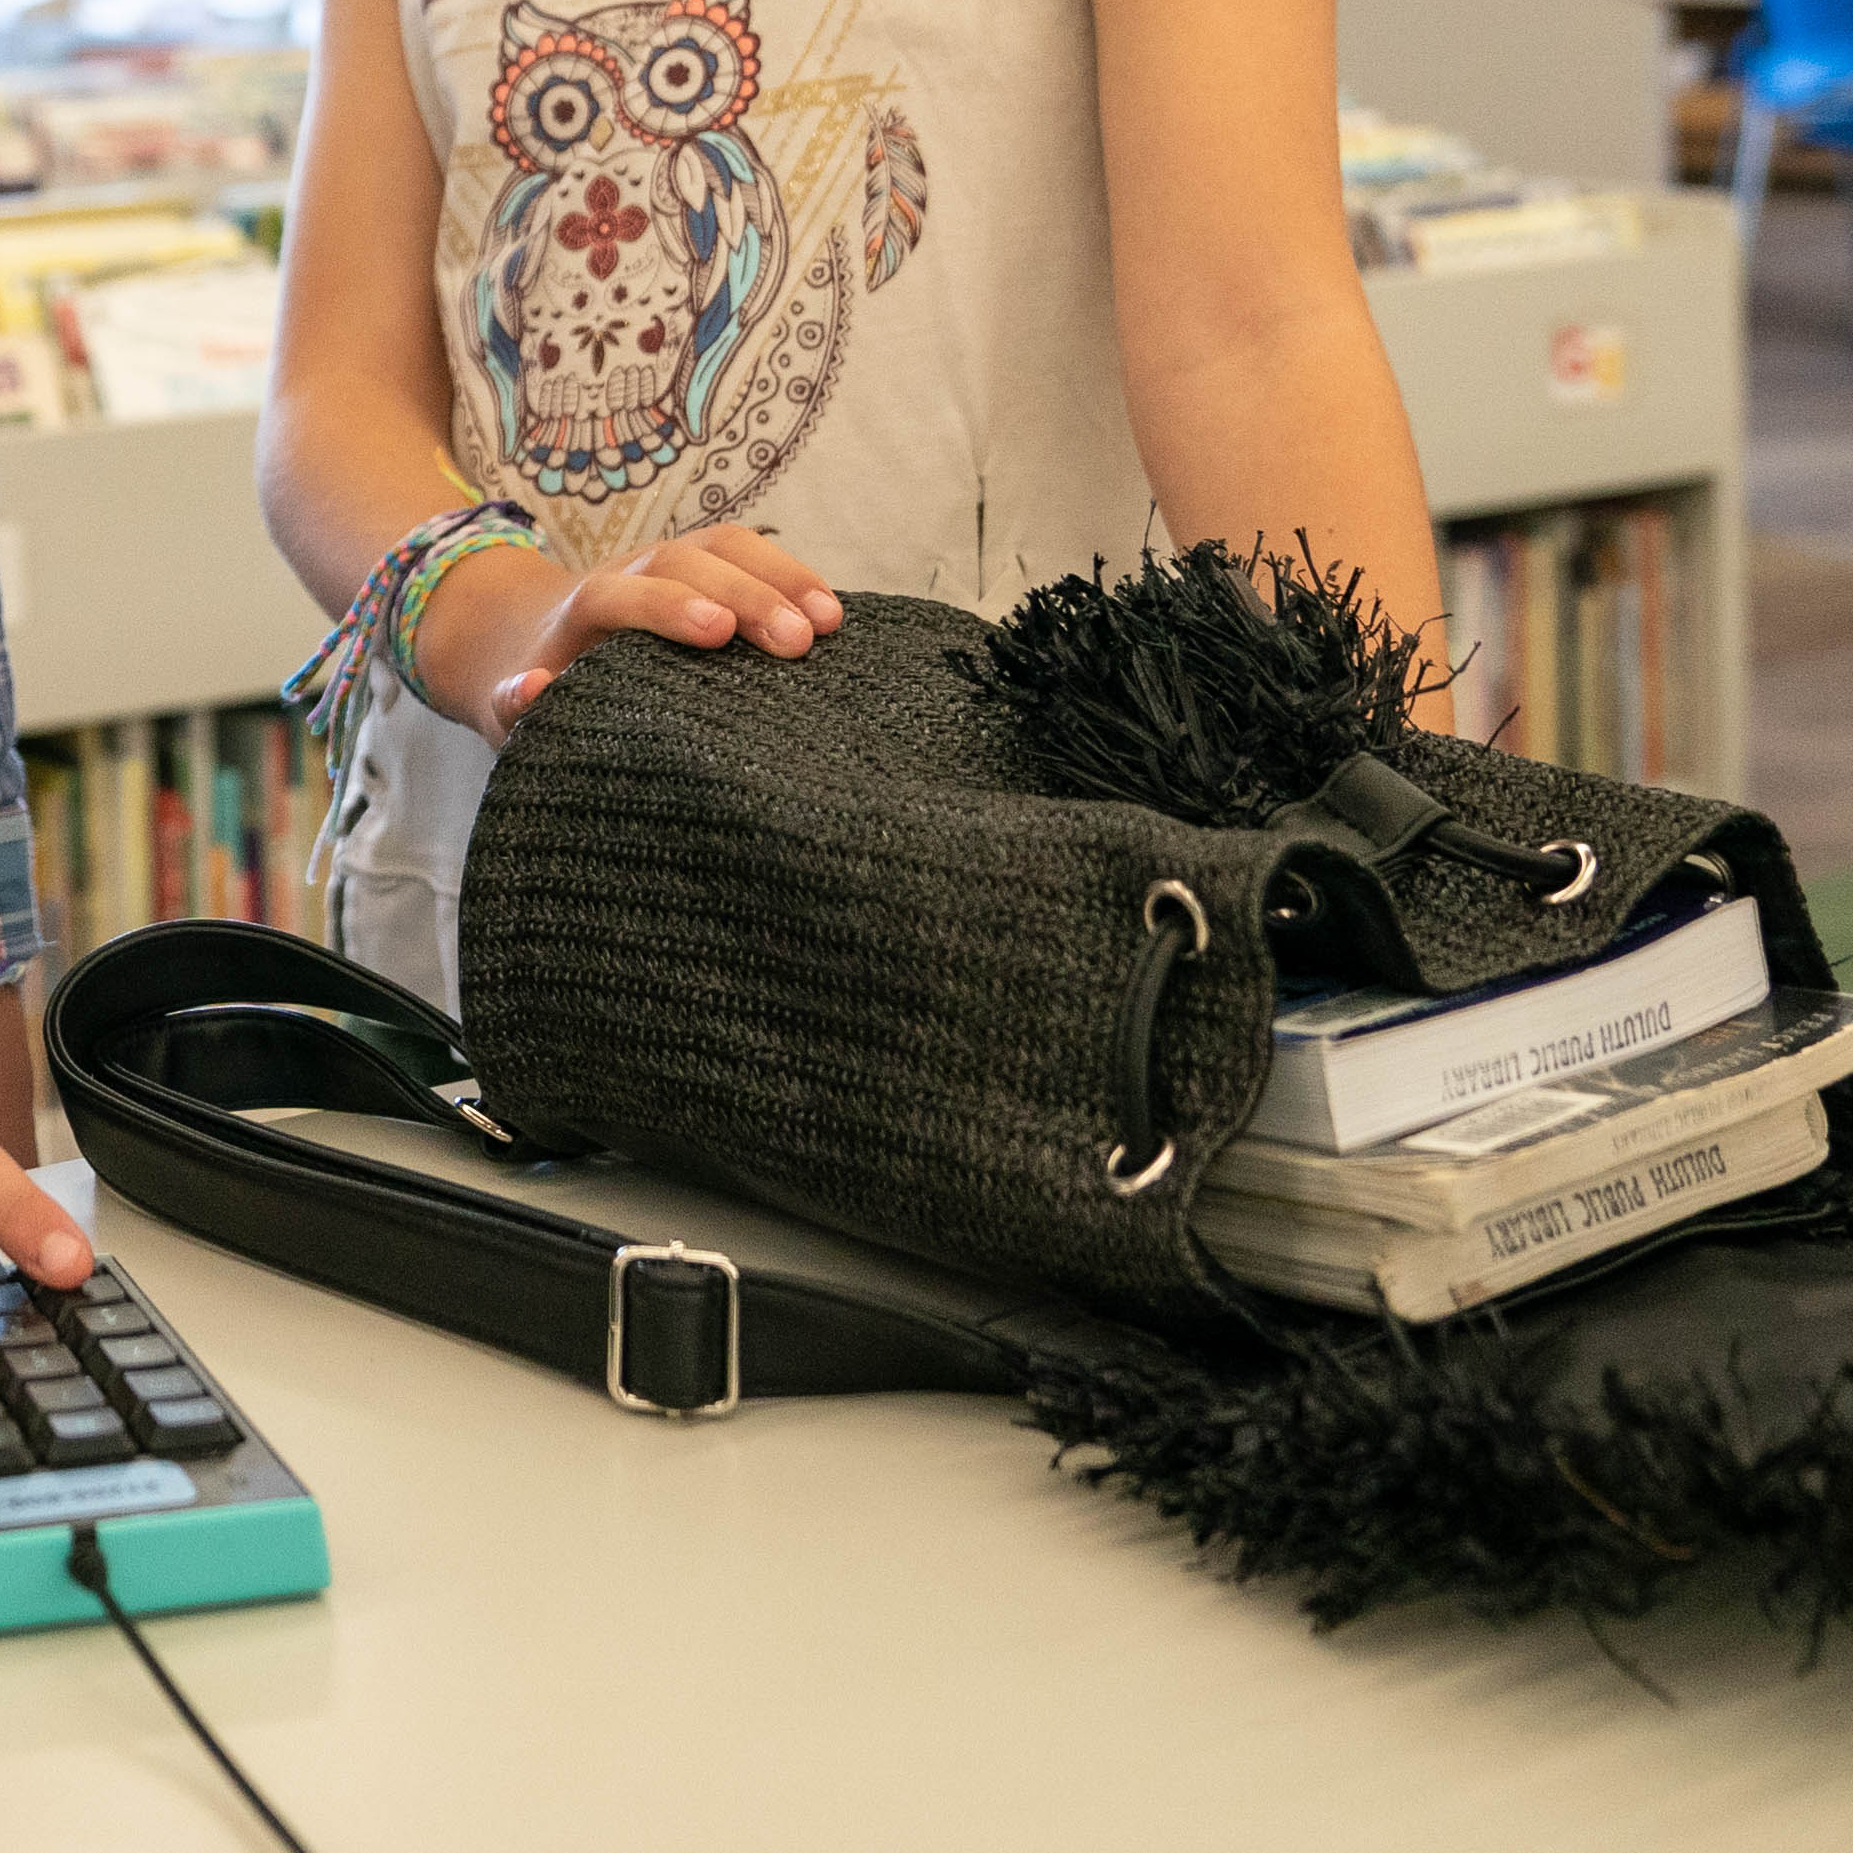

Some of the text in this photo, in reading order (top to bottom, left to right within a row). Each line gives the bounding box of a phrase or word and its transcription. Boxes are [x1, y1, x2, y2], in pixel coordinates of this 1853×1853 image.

[1528, 1031, 1595, 1077] PUBLIC
[1599, 1001, 1672, 1055] DULUTH
[1441, 1051, 1523, 1103] LIBRARY
[1484, 1143, 1727, 1259] DULUTH PUBLIC LIBRARY
